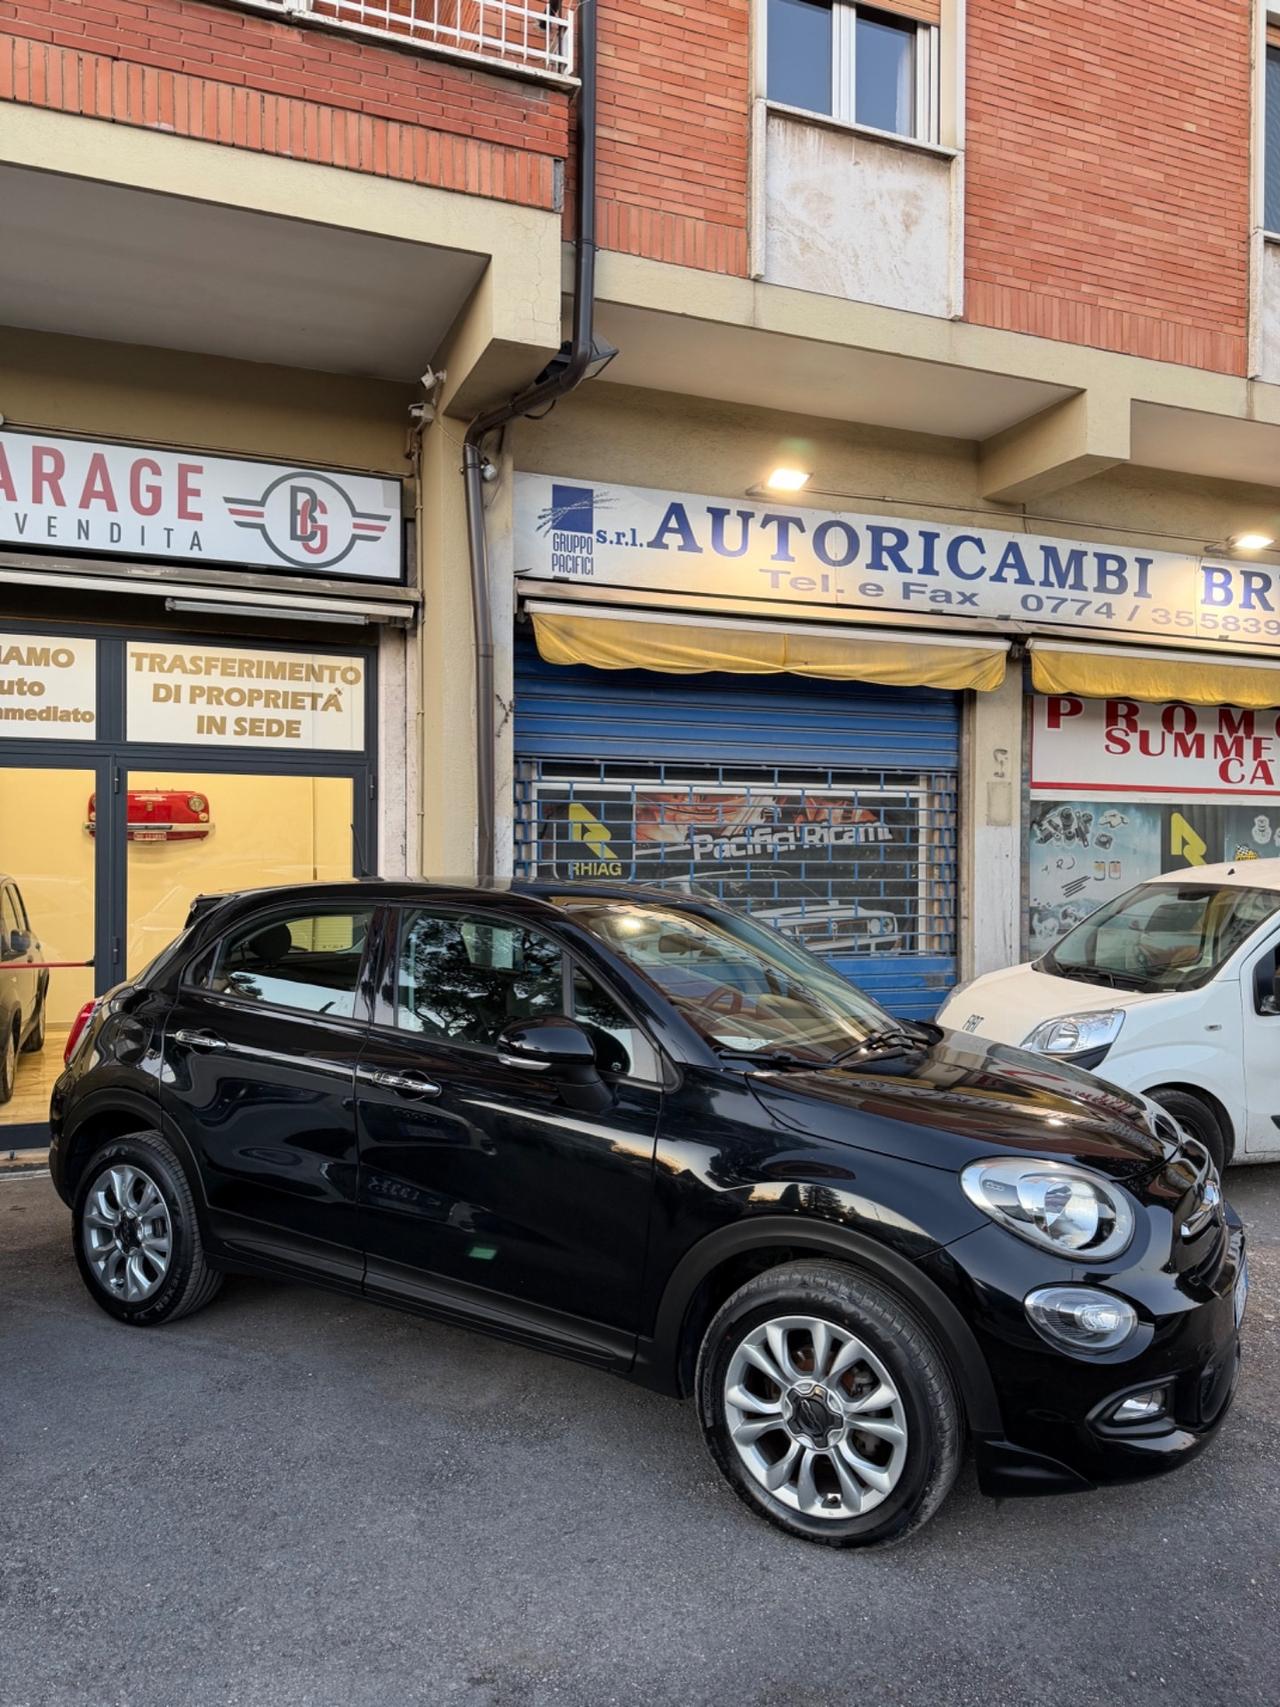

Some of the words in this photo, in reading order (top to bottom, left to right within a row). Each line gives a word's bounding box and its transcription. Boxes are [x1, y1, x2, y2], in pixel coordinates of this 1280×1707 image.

[14, 512, 203, 552] VENDITA
[553, 532, 593, 555] GRUPPO
[552, 553, 594, 575] PACIFICI
[596, 528, 643, 548] s.r.l.
[647, 501, 1153, 599] AUTORICAMBI
[1200, 565, 1280, 612] BR
[759, 568, 845, 593] Tel.
[858, 581, 885, 597] e
[902, 581, 979, 606] Fax
[1020, 594, 1116, 619] 0774
[130, 652, 362, 685] TRASFERIMENTO
[152, 683, 182, 704] DI
[189, 685, 344, 713] PROPRIETÀ
[0, 705, 95, 724] mediato
[197, 715, 227, 735] IN
[233, 717, 302, 739] SEDE
[1046, 696, 1280, 740] PROM
[1105, 727, 1276, 763] SUMME
[1218, 757, 1275, 786] CA
[568, 861, 622, 876] RHIAG
